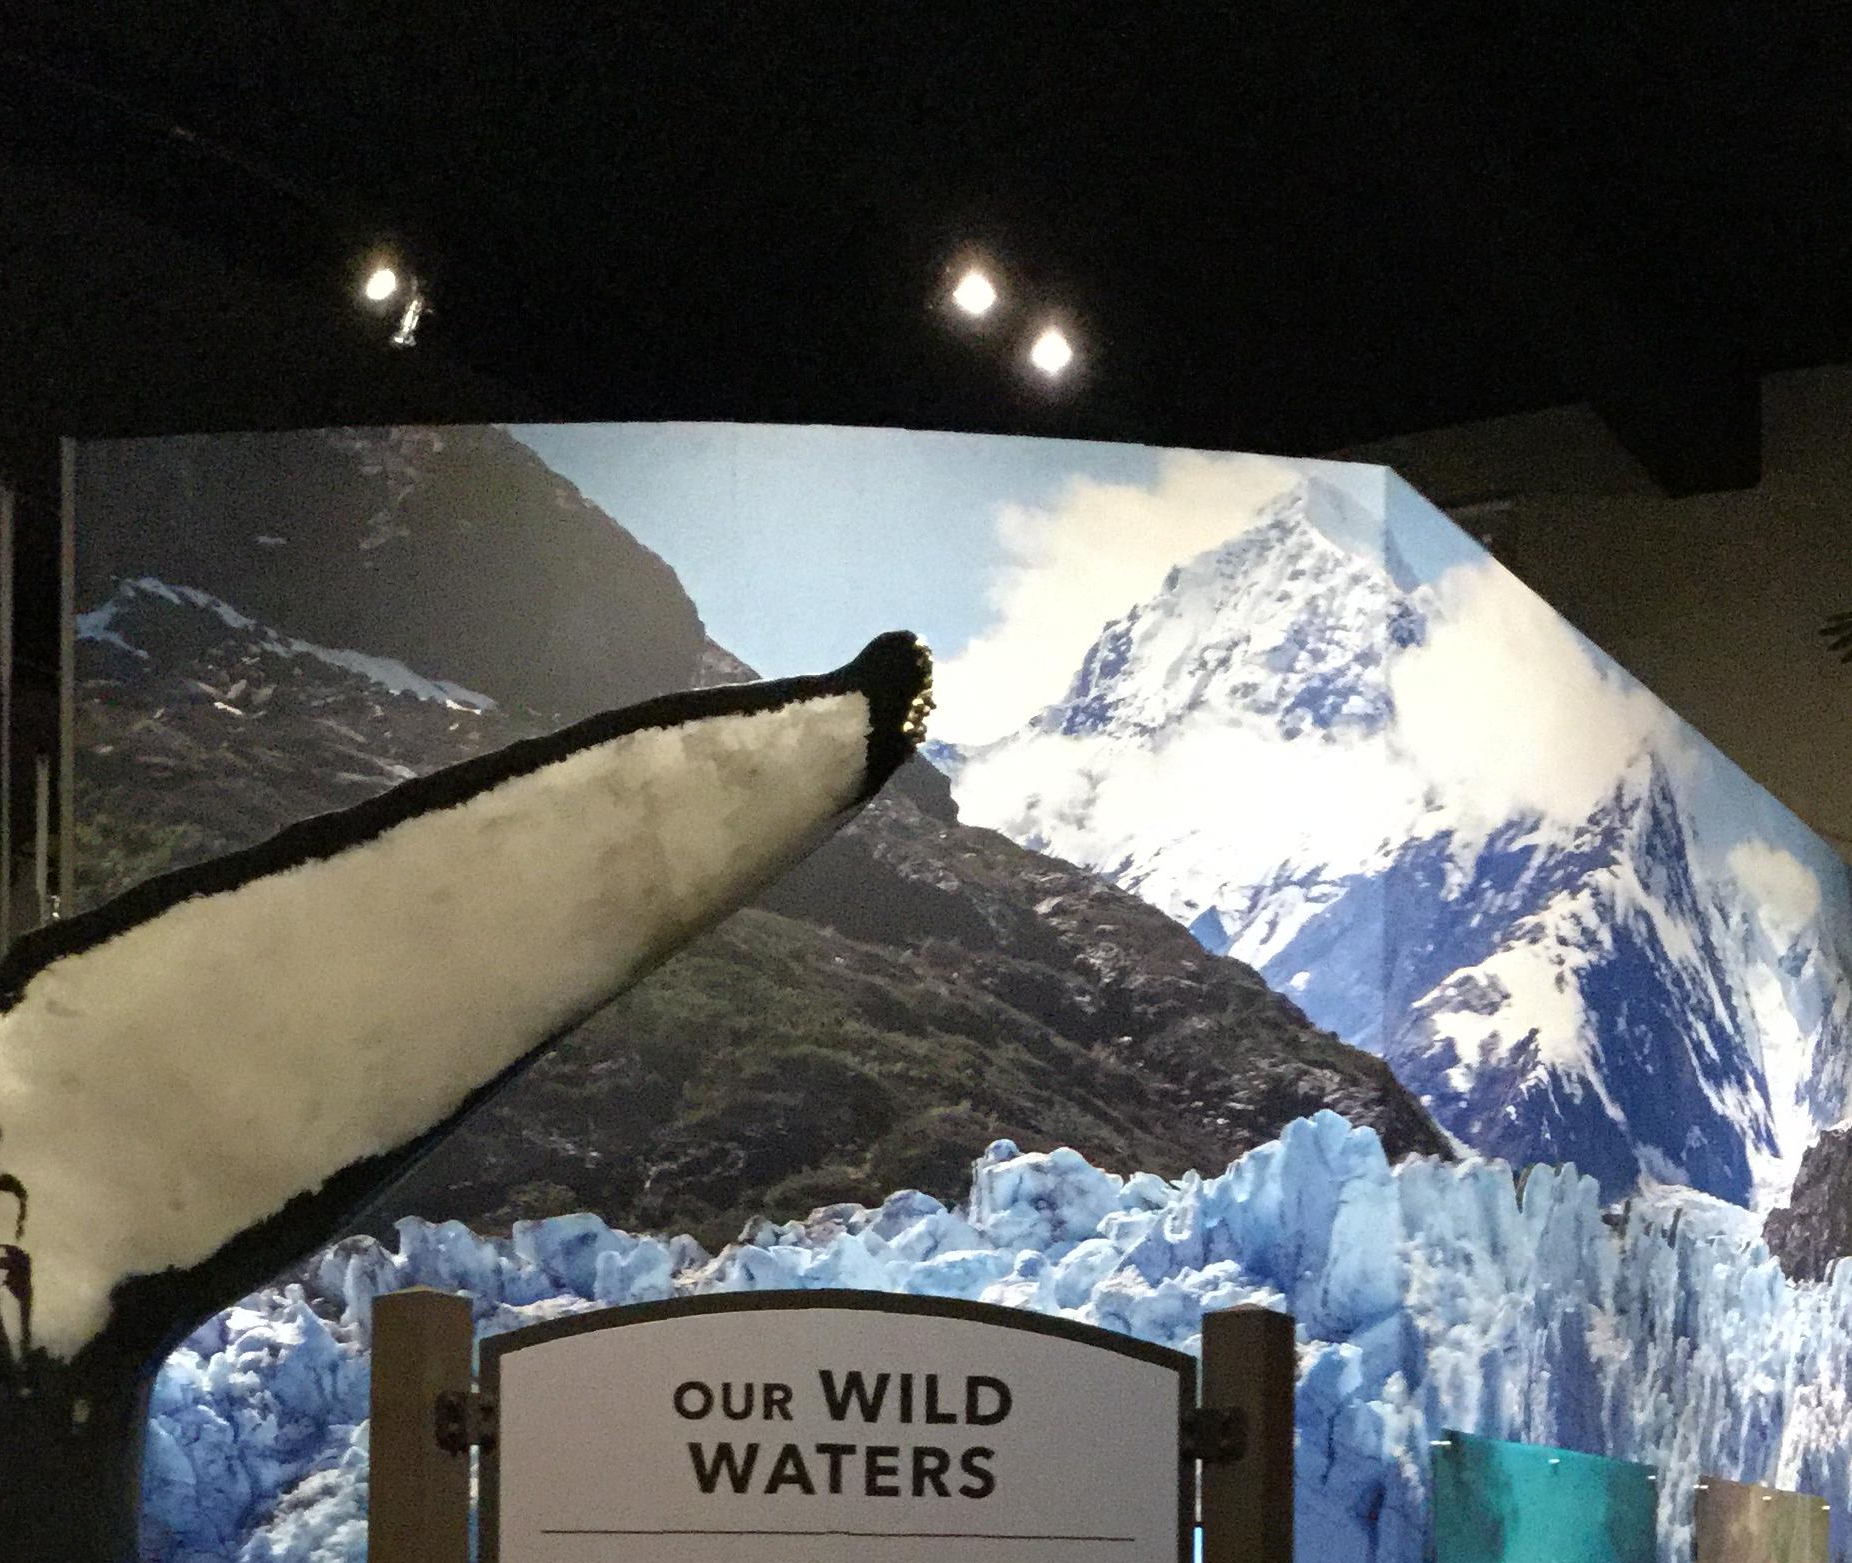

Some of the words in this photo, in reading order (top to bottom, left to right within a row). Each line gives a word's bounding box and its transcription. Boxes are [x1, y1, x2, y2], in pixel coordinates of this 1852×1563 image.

[673, 1380, 793, 1422] OUR
[819, 1370, 1013, 1425] WILD
[688, 1442, 996, 1499] WATERS
